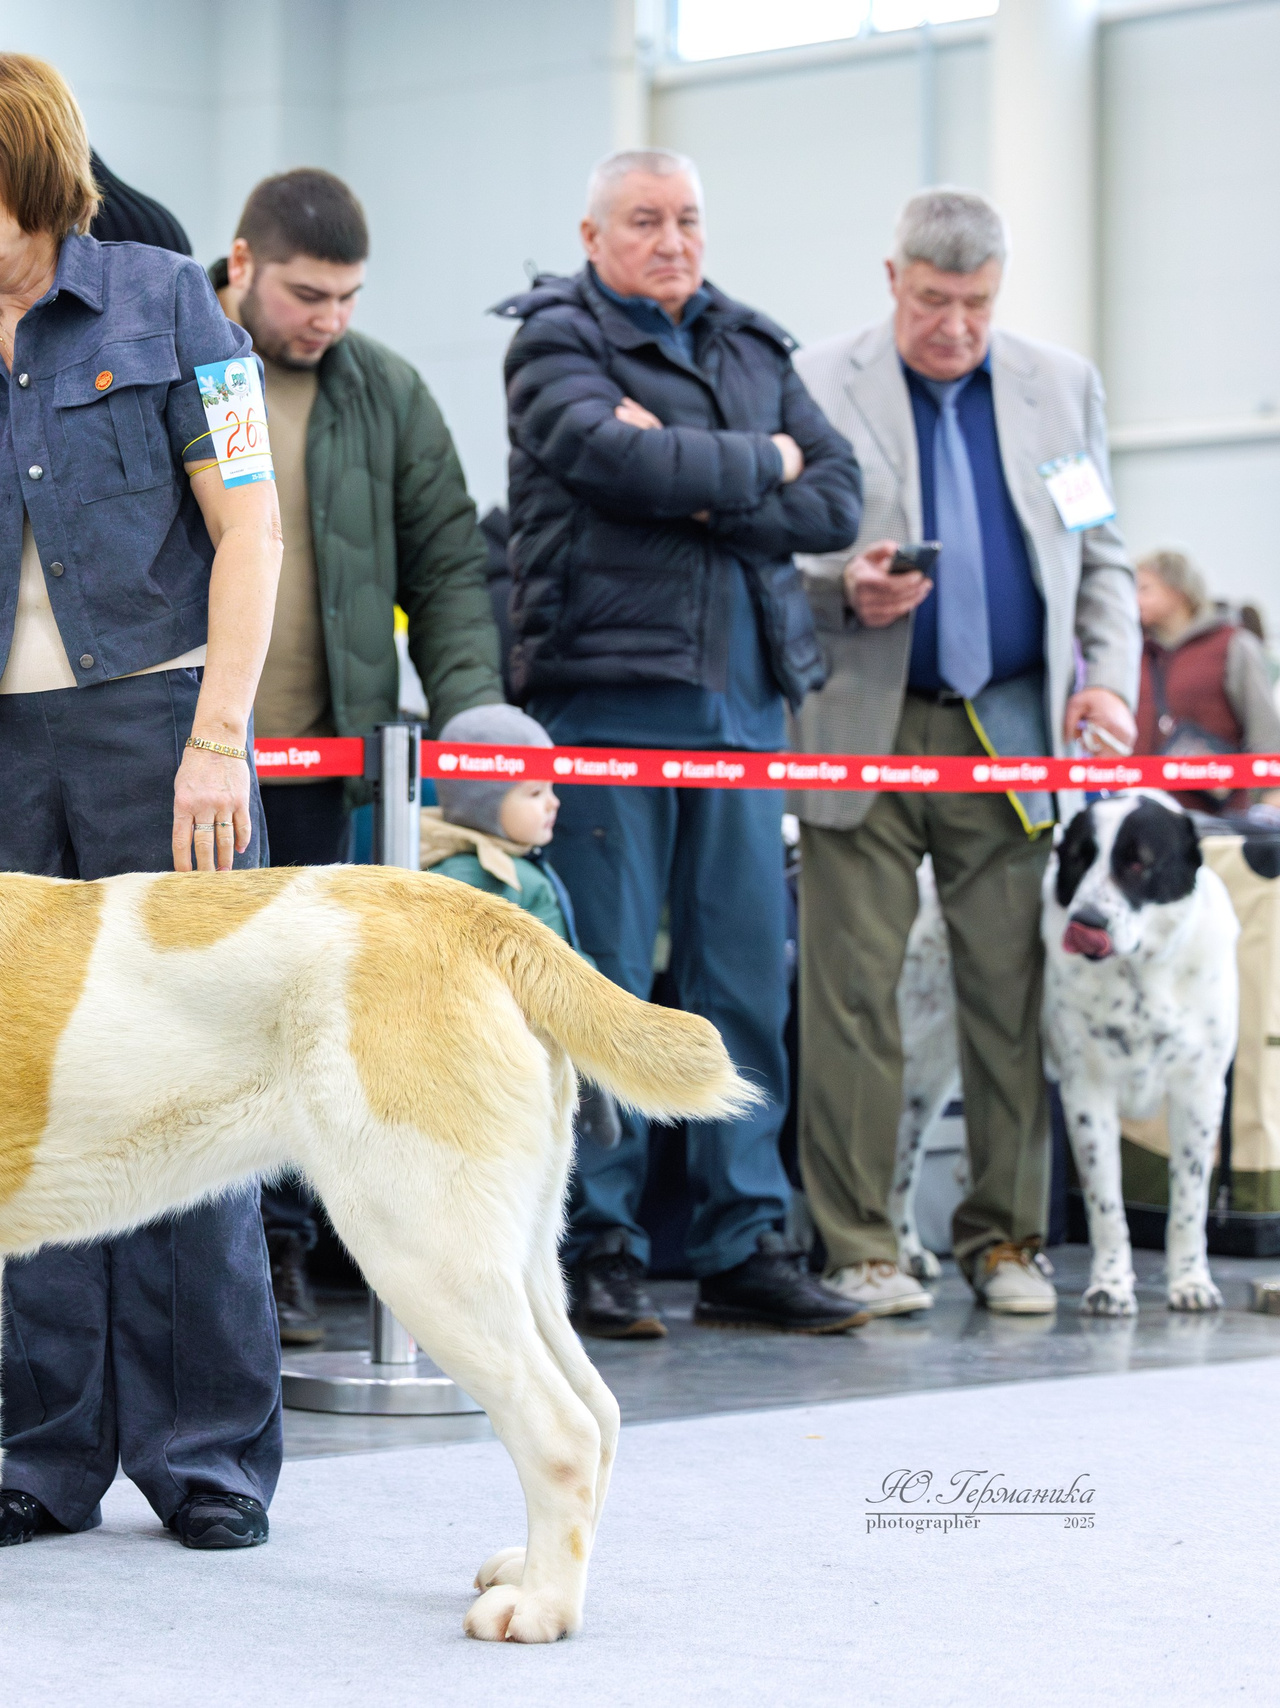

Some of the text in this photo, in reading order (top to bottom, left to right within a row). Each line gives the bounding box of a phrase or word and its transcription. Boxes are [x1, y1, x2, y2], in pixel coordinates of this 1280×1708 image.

[225, 407, 257, 459] 26
[288, 747, 321, 768] Expo
[458, 754, 525, 776] Kazan Expo
[574, 758, 638, 779] Kazan Expo
[682, 760, 745, 782] Kazan Expo
